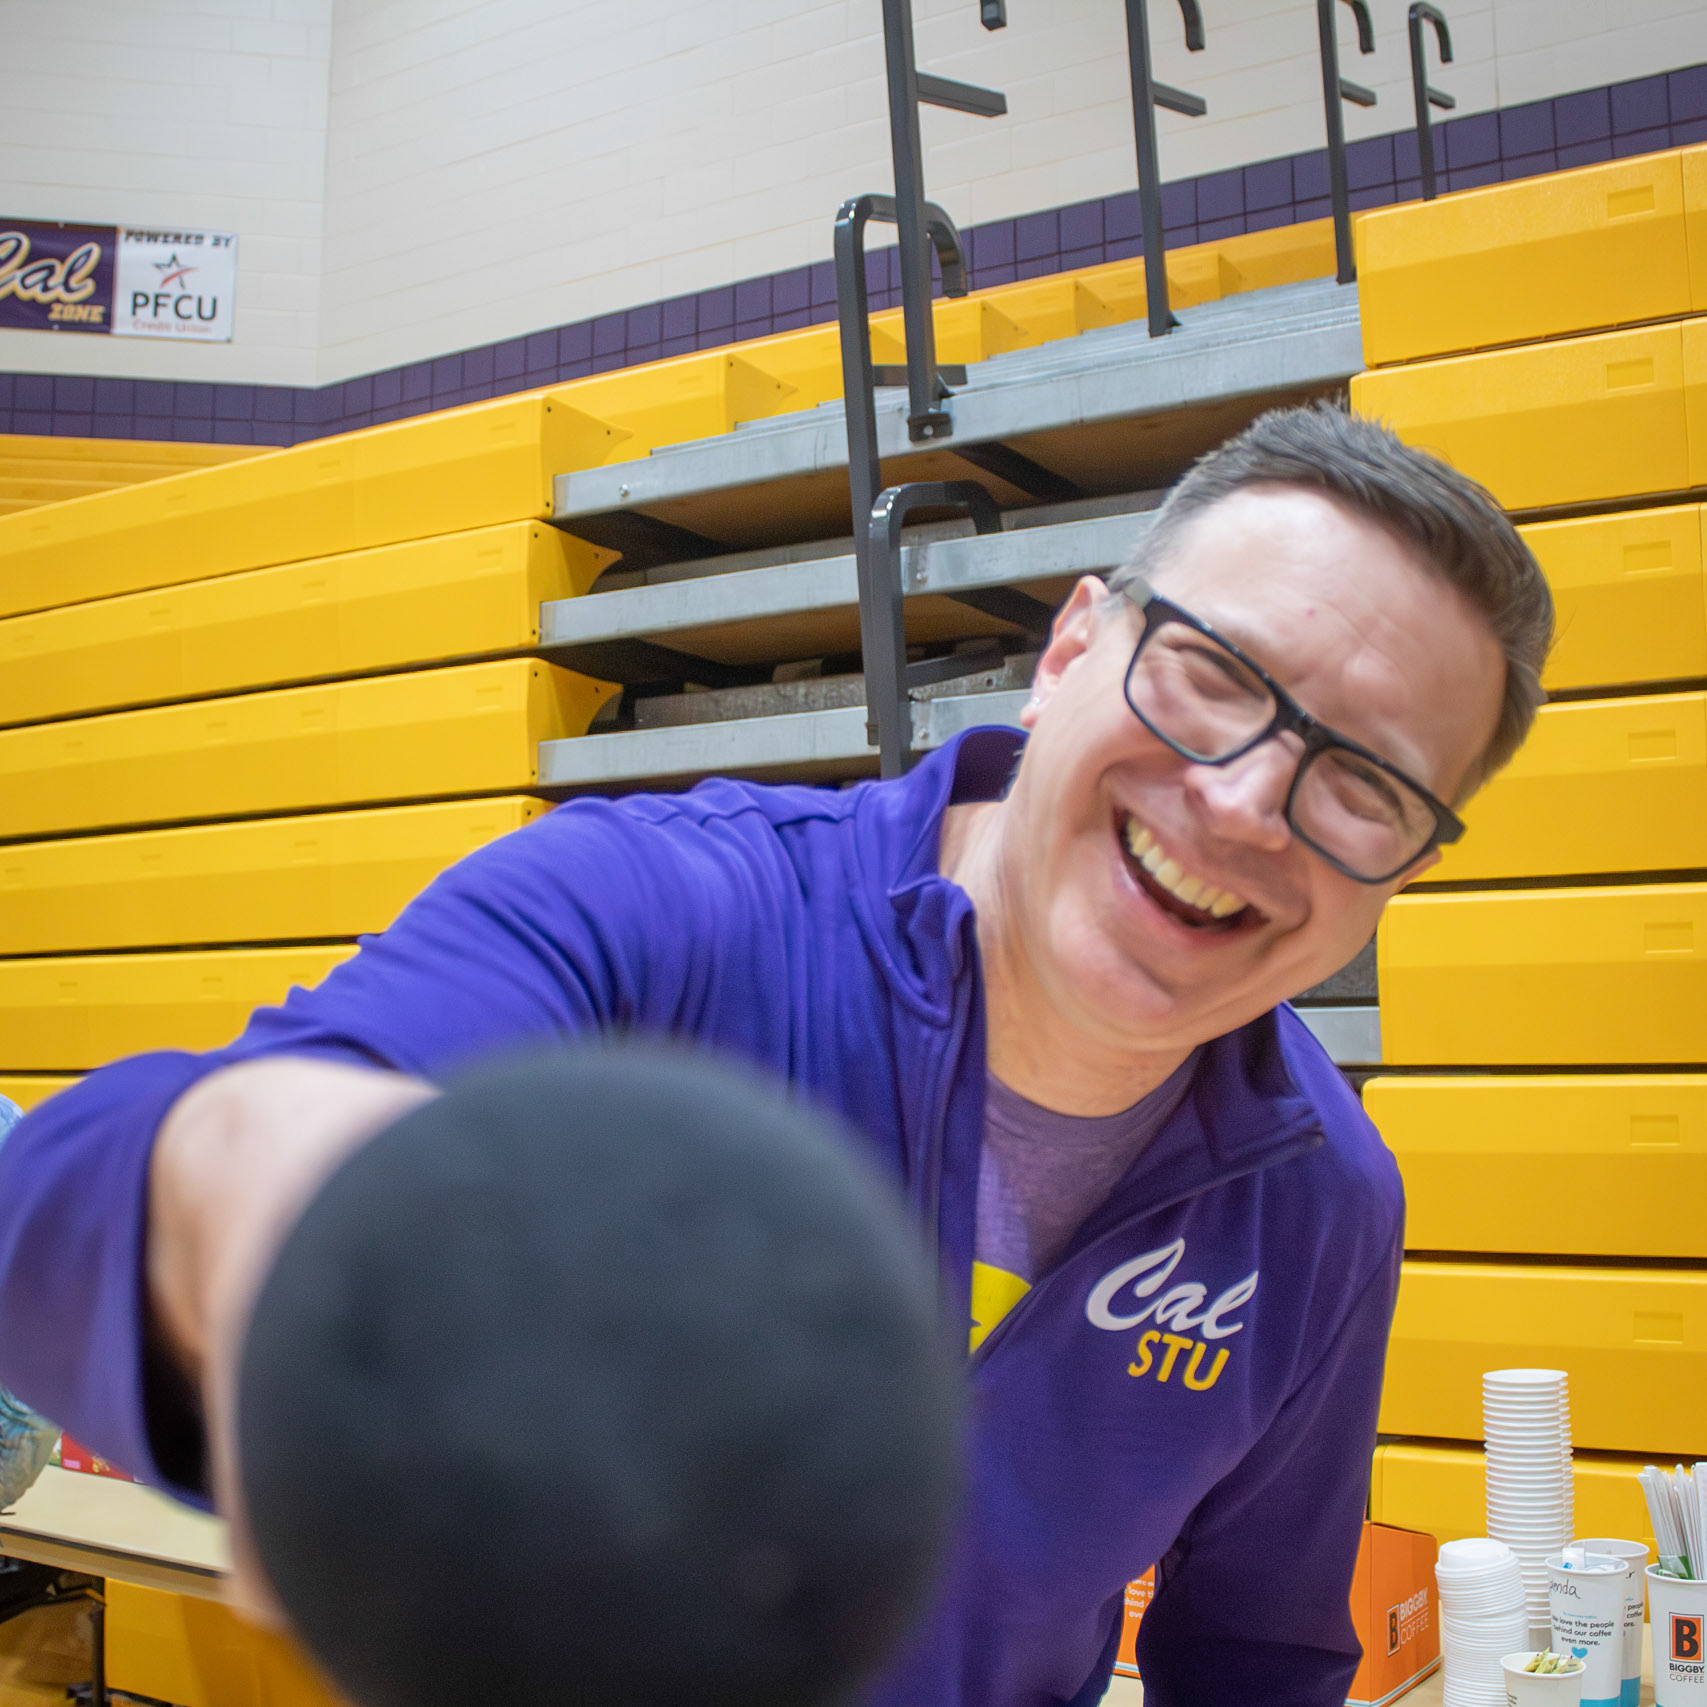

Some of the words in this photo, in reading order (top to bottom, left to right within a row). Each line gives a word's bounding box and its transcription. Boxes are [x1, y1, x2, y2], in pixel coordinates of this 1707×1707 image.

[124, 229, 204, 246] POWERED
[211, 234, 233, 248] BY
[48, 302, 105, 323] ZONE
[131, 291, 218, 321] PFCU
[133, 319, 172, 333] Credit
[175, 322, 212, 334] Union
[1086, 1237, 1259, 1340] Cal
[1128, 1330, 1230, 1391] STU
[1128, 1586, 1146, 1597] love
[1400, 1587, 1428, 1621] BIGGBY
[1390, 1612, 1398, 1649] B
[1400, 1611, 1429, 1645] COFFEE
[1553, 1624, 1573, 1635] behind
[1589, 1629, 1612, 1637] coffee
[1559, 1616, 1573, 1625] love
[1574, 1619, 1588, 1628] the
[1590, 1620, 1615, 1629] people
[1561, 1635, 1577, 1644] even
[1578, 1639, 1601, 1647] more.
[1675, 1619, 1699, 1658] B
[1669, 1662, 1705, 1674] BIGGBY
[1669, 1673, 1705, 1684] COFFEE
